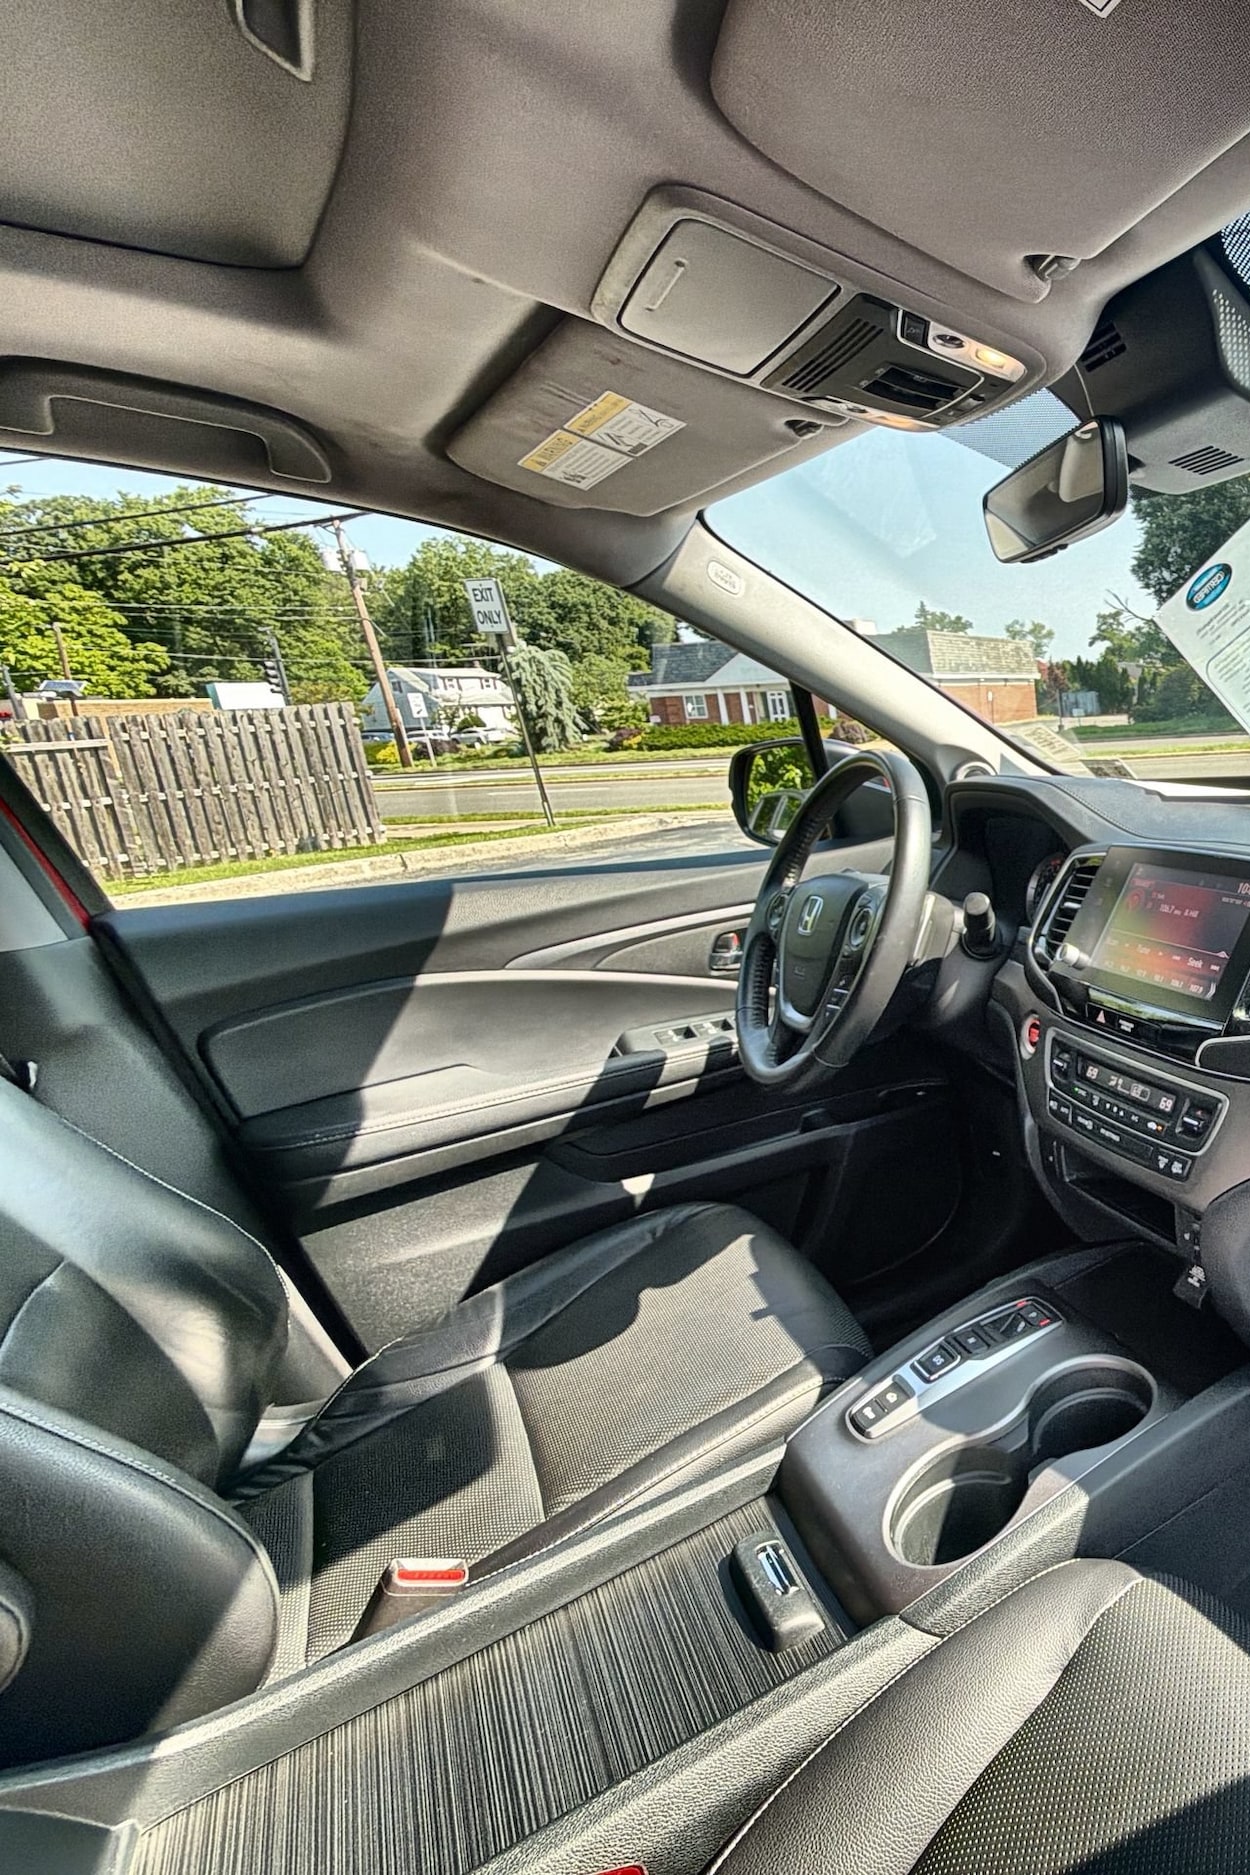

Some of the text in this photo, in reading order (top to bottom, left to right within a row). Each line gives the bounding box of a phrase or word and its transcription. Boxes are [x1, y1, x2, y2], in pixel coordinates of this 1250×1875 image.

[472, 588, 494, 602] EXIT
[477, 610, 502, 624] ONLY
[1159, 1097, 1174, 1112] 69
